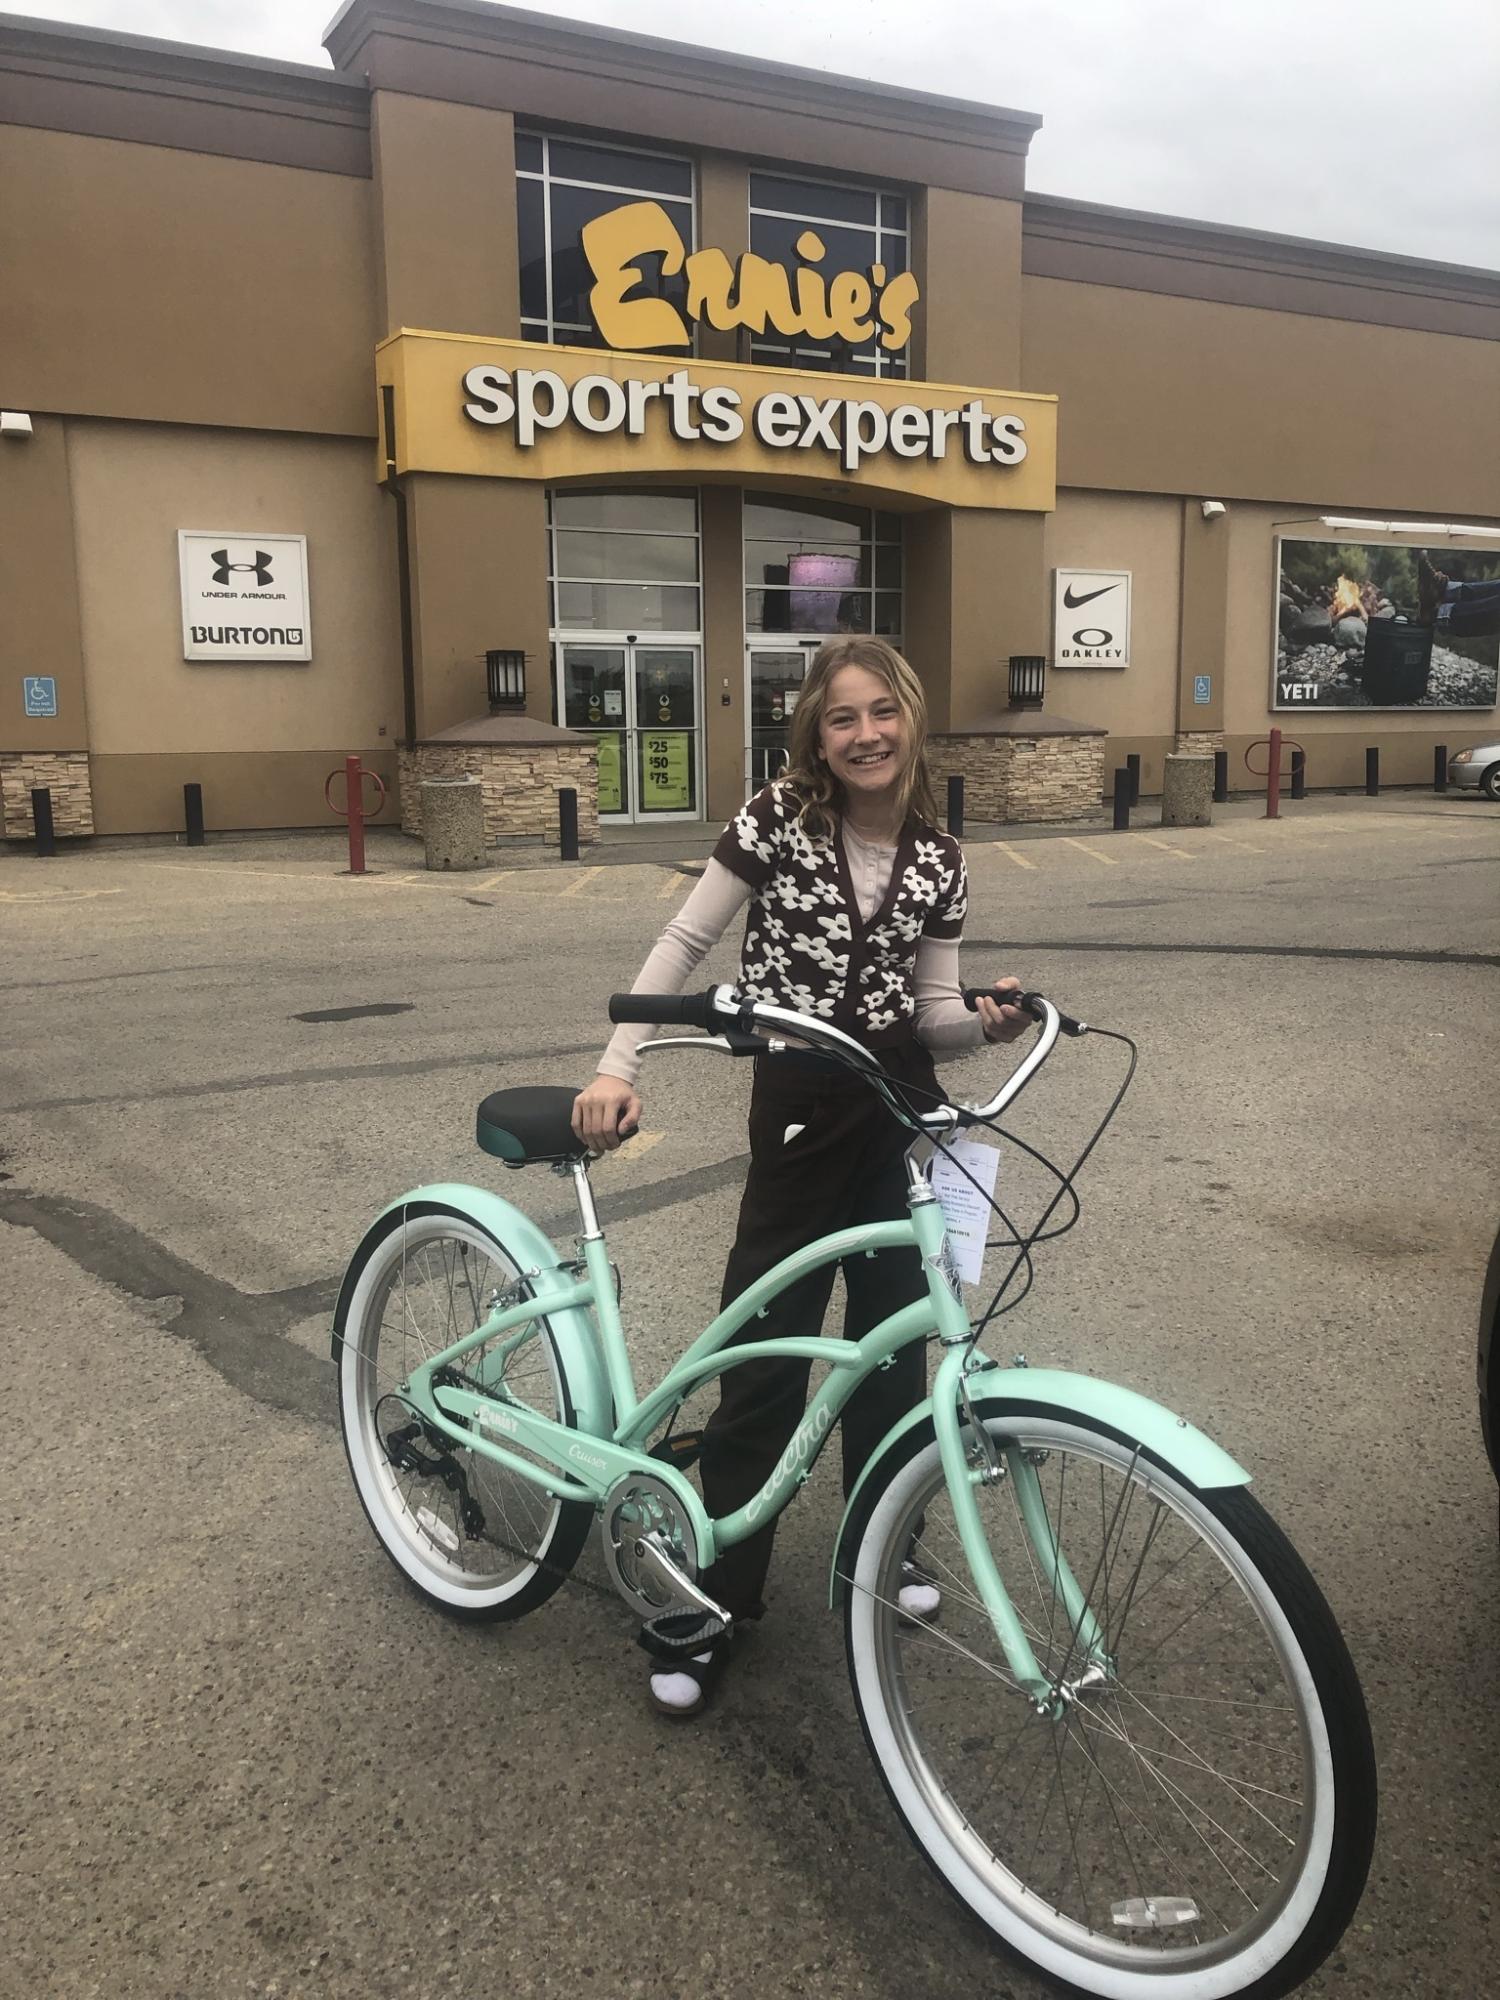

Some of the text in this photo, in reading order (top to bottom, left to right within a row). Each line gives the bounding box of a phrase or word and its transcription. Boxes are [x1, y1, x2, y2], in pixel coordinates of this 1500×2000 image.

[582, 201, 919, 350] Ernie's
[462, 365, 1028, 471] sports experts
[241, 592, 285, 600] ARMOUR
[190, 626, 285, 645] BURTON
[1062, 649, 1121, 658] OAKLEY
[1281, 683, 1318, 699] YETI
[648, 741, 668, 753] $25
[649, 756, 669, 769] $50
[650, 772, 669, 784] $75
[568, 1443, 608, 1471] Cruiser
